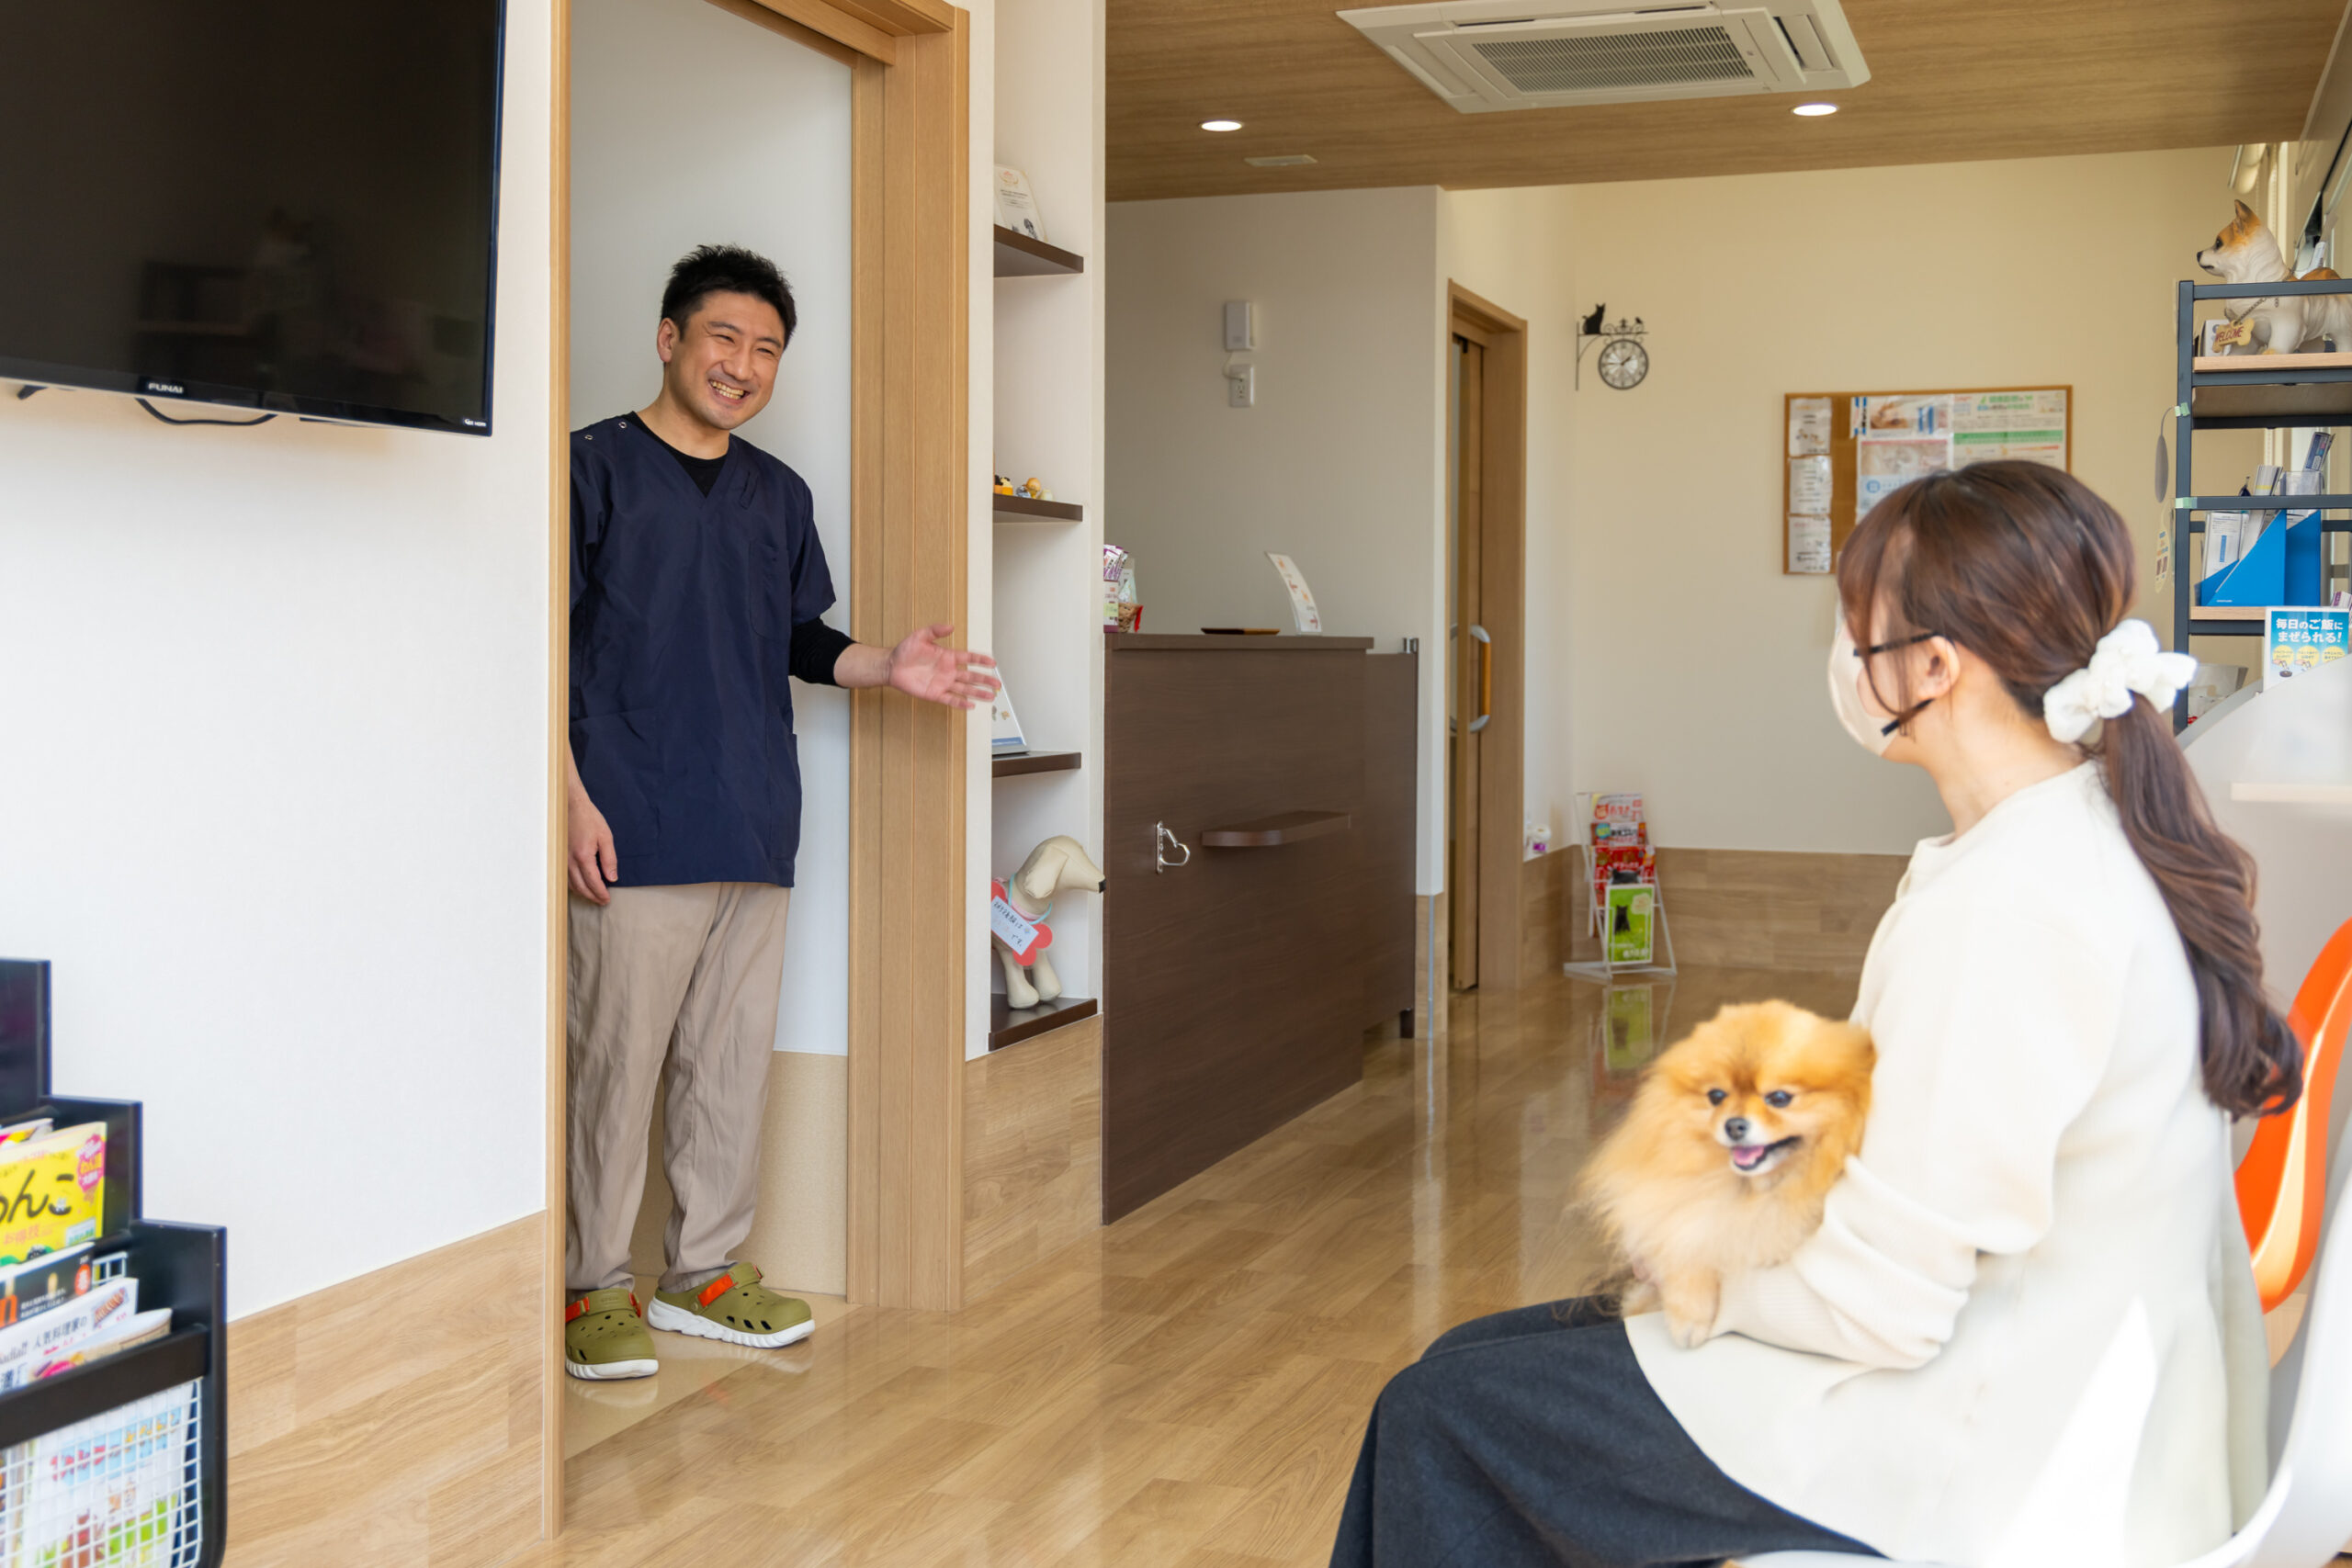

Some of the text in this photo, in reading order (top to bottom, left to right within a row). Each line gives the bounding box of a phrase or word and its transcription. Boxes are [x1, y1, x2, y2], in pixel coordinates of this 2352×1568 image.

[148, 382, 184, 394] FUNAI
[2276, 618, 2344, 630] 毎日のご飯に
